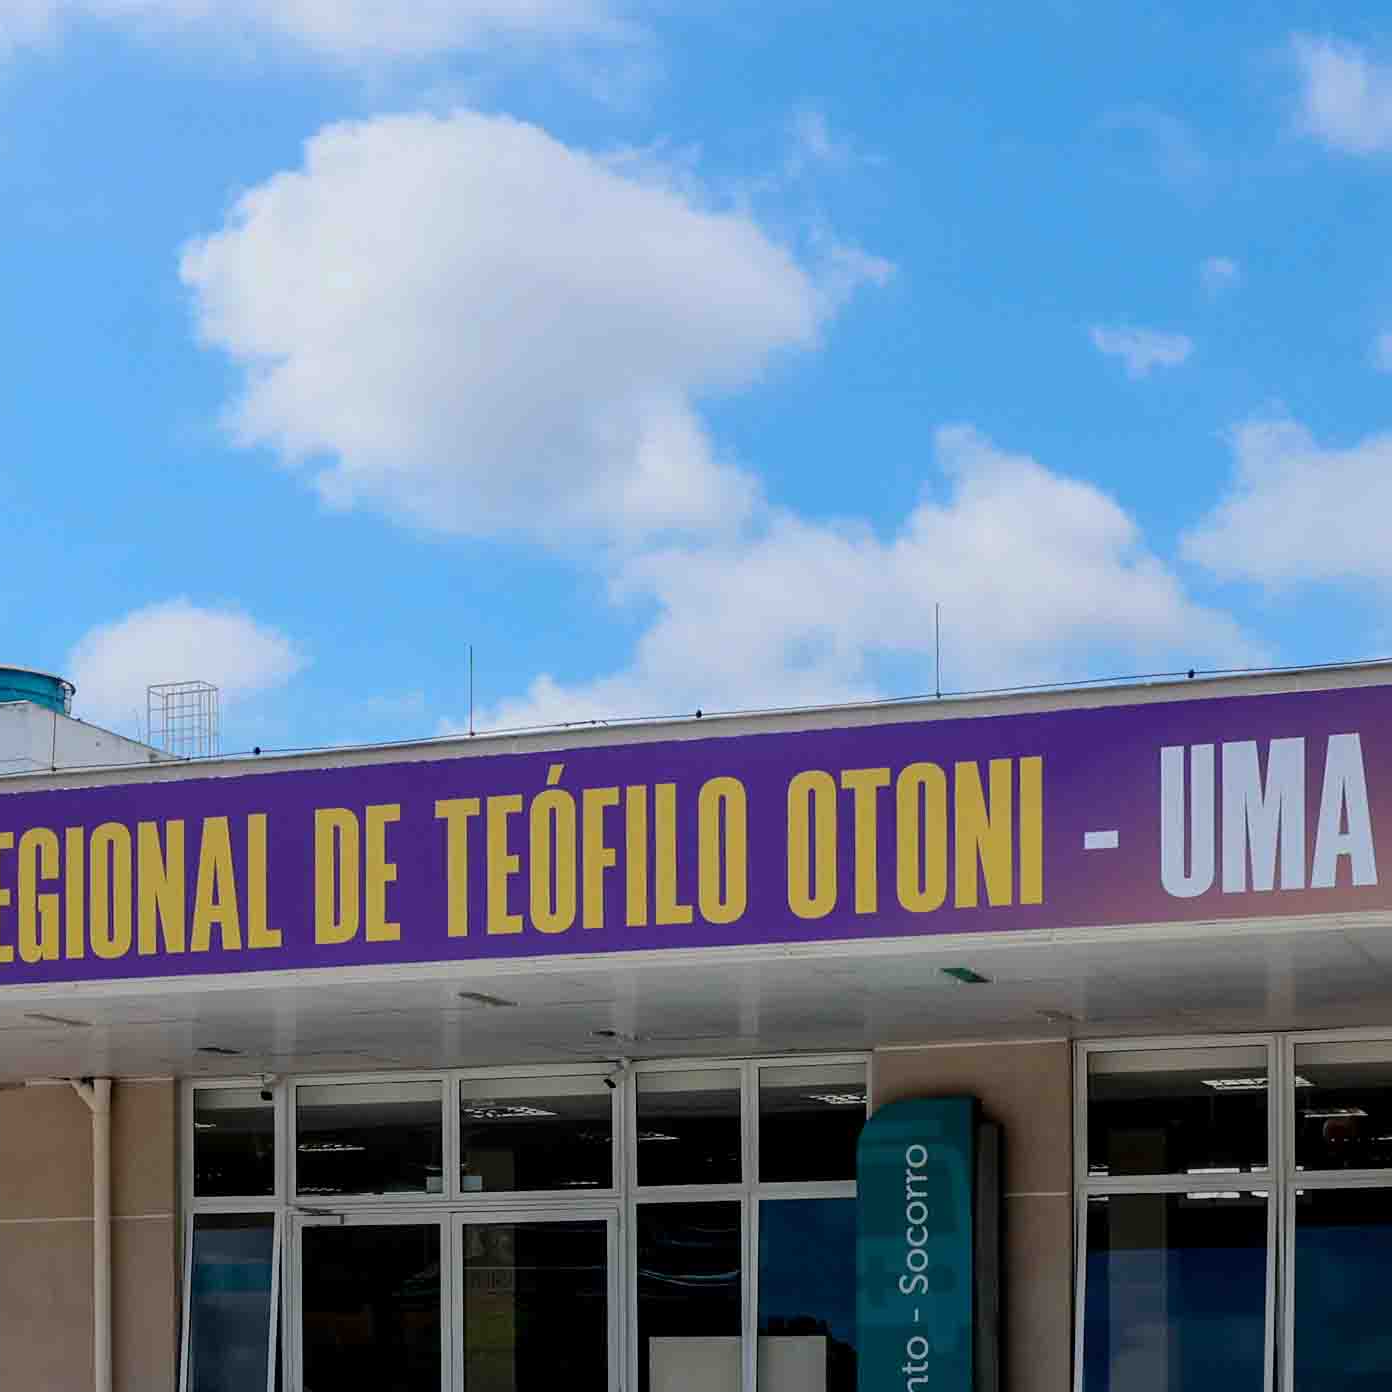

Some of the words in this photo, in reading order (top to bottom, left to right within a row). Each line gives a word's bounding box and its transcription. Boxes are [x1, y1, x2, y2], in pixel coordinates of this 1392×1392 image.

[314, 804, 401, 945] DE
[434, 764, 747, 937] TEÓFILO
[787, 756, 1043, 919] OTONI
[1084, 830, 1119, 849] -
[1160, 733, 1378, 898] UMA
[899, 1143, 928, 1294] Socorro
